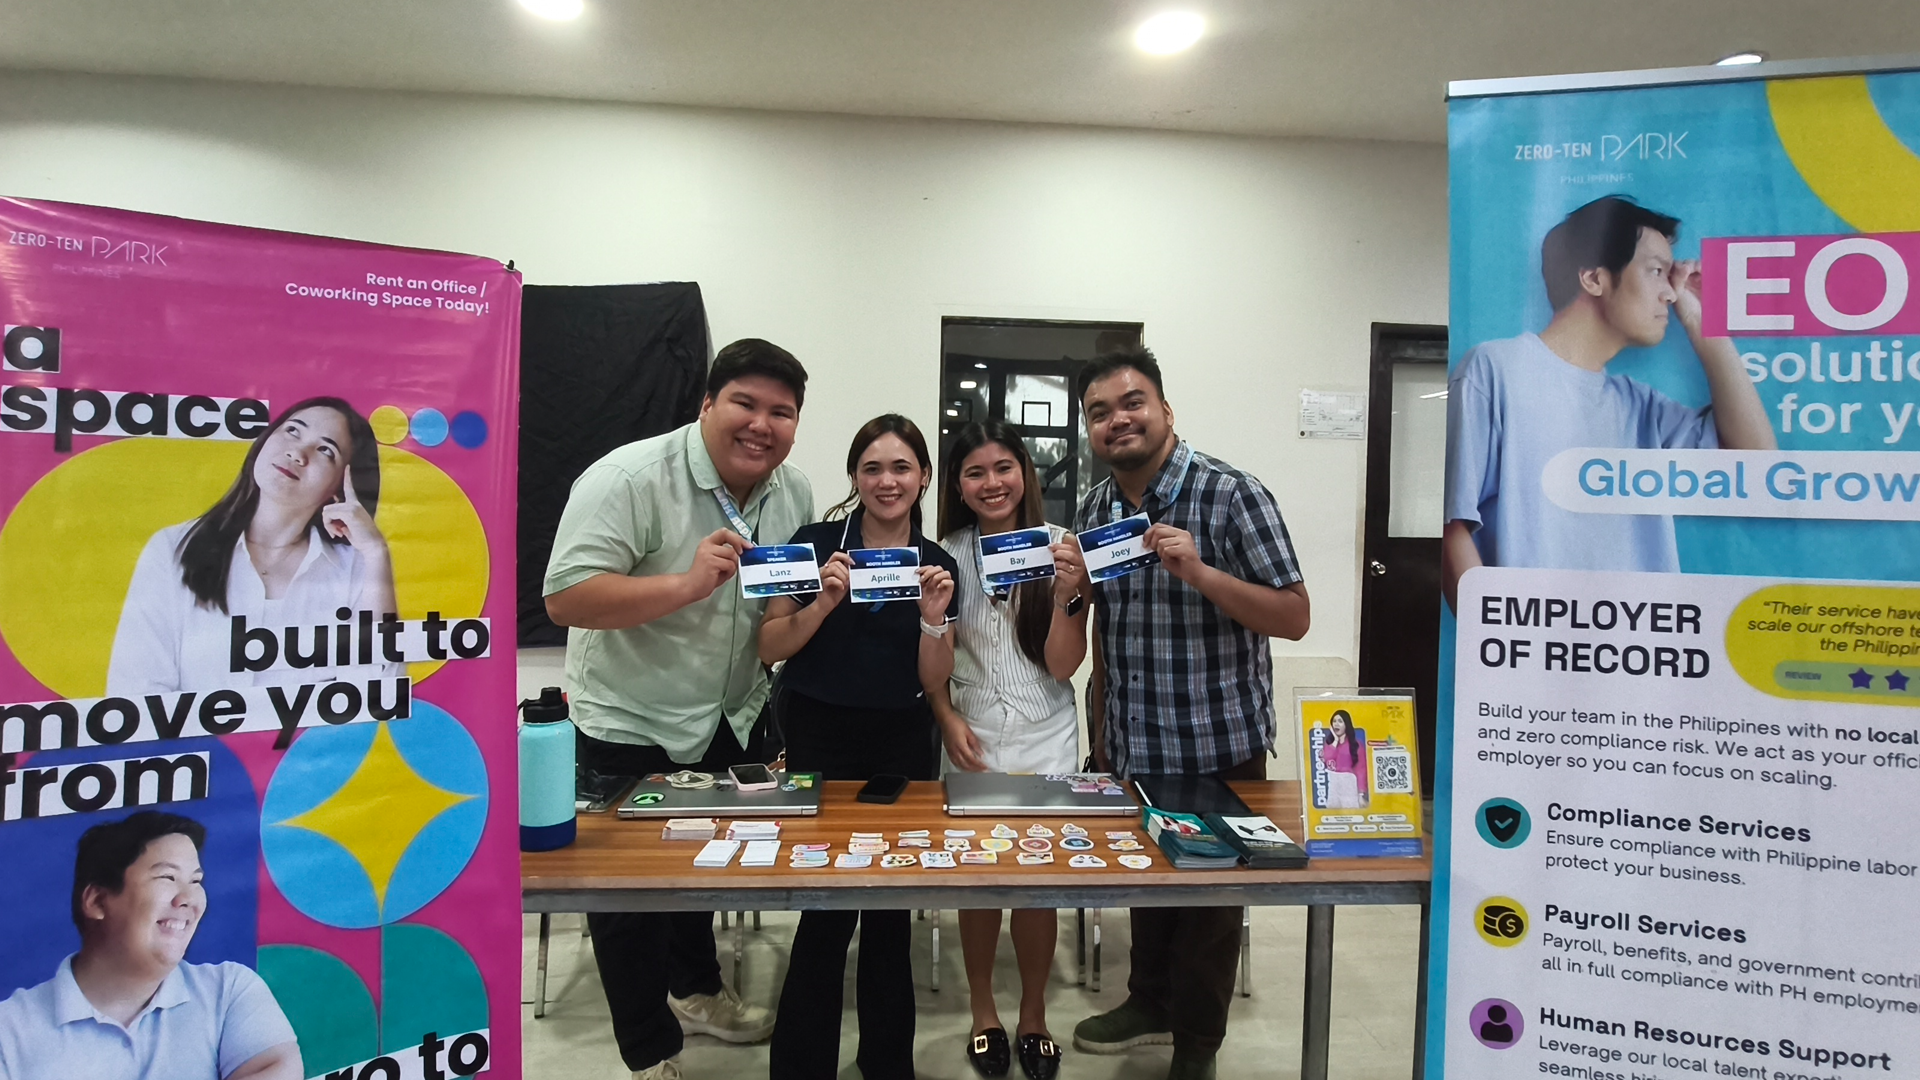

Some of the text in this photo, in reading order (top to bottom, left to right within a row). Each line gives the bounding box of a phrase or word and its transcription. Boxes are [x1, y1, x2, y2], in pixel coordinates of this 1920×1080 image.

[1515, 131, 1689, 161] ZERO-TEN PARK
[1560, 172, 1634, 185] PHILIPPINES
[9, 231, 168, 267] ZERO-TEN PARK
[285, 282, 490, 316] Coworking Space Today!
[366, 272, 404, 289] Rent
[406, 279, 427, 291] an
[431, 277, 477, 295] Office
[1727, 238, 1909, 332] EO
[3, 326, 60, 372] a
[1, 385, 269, 452] space
[1777, 393, 1920, 444] for y
[1578, 458, 1920, 502] Global Grow
[769, 569, 792, 577] Lanz
[1010, 557, 1026, 565] Bay
[1110, 547, 1131, 559] Joey
[871, 573, 901, 584] Aprille
[1481, 596, 1702, 634] EMPLOYER
[1747, 619, 1792, 632] scale
[1796, 622, 1826, 633] our
[1830, 621, 1904, 638] offshore
[1817, 604, 1882, 619] service
[230, 607, 490, 672] built to
[1480, 637, 1710, 679] OF RECORD
[1820, 637, 1848, 652] the
[1785, 670, 1822, 681] REVIEW
[0, 677, 410, 753] move you
[1479, 702, 1919, 745] Build your team in the Philippines with no local
[1478, 725, 1920, 769] and zero compliance risk. We act as your offic
[1477, 747, 1837, 791] employer so you can focus on scaling.
[1547, 802, 1812, 843] Compliance Services
[1545, 853, 1746, 886] protect your business.
[1546, 830, 1918, 877] Ensure compliance with Philippine labor
[1545, 904, 1747, 943] Payroll Services
[1543, 933, 1920, 989] Payroll, benefits, and government contri
[1542, 955, 1920, 1014] all in full compliance with PH employme
[419, 1032, 489, 1080] to
[1539, 1035, 1622, 1063] Leverage
[1628, 1050, 1657, 1066] our
[1662, 1052, 1708, 1073] local
[1714, 1060, 1768, 1080] talent
[1540, 1007, 1892, 1071] Human Resources Support
